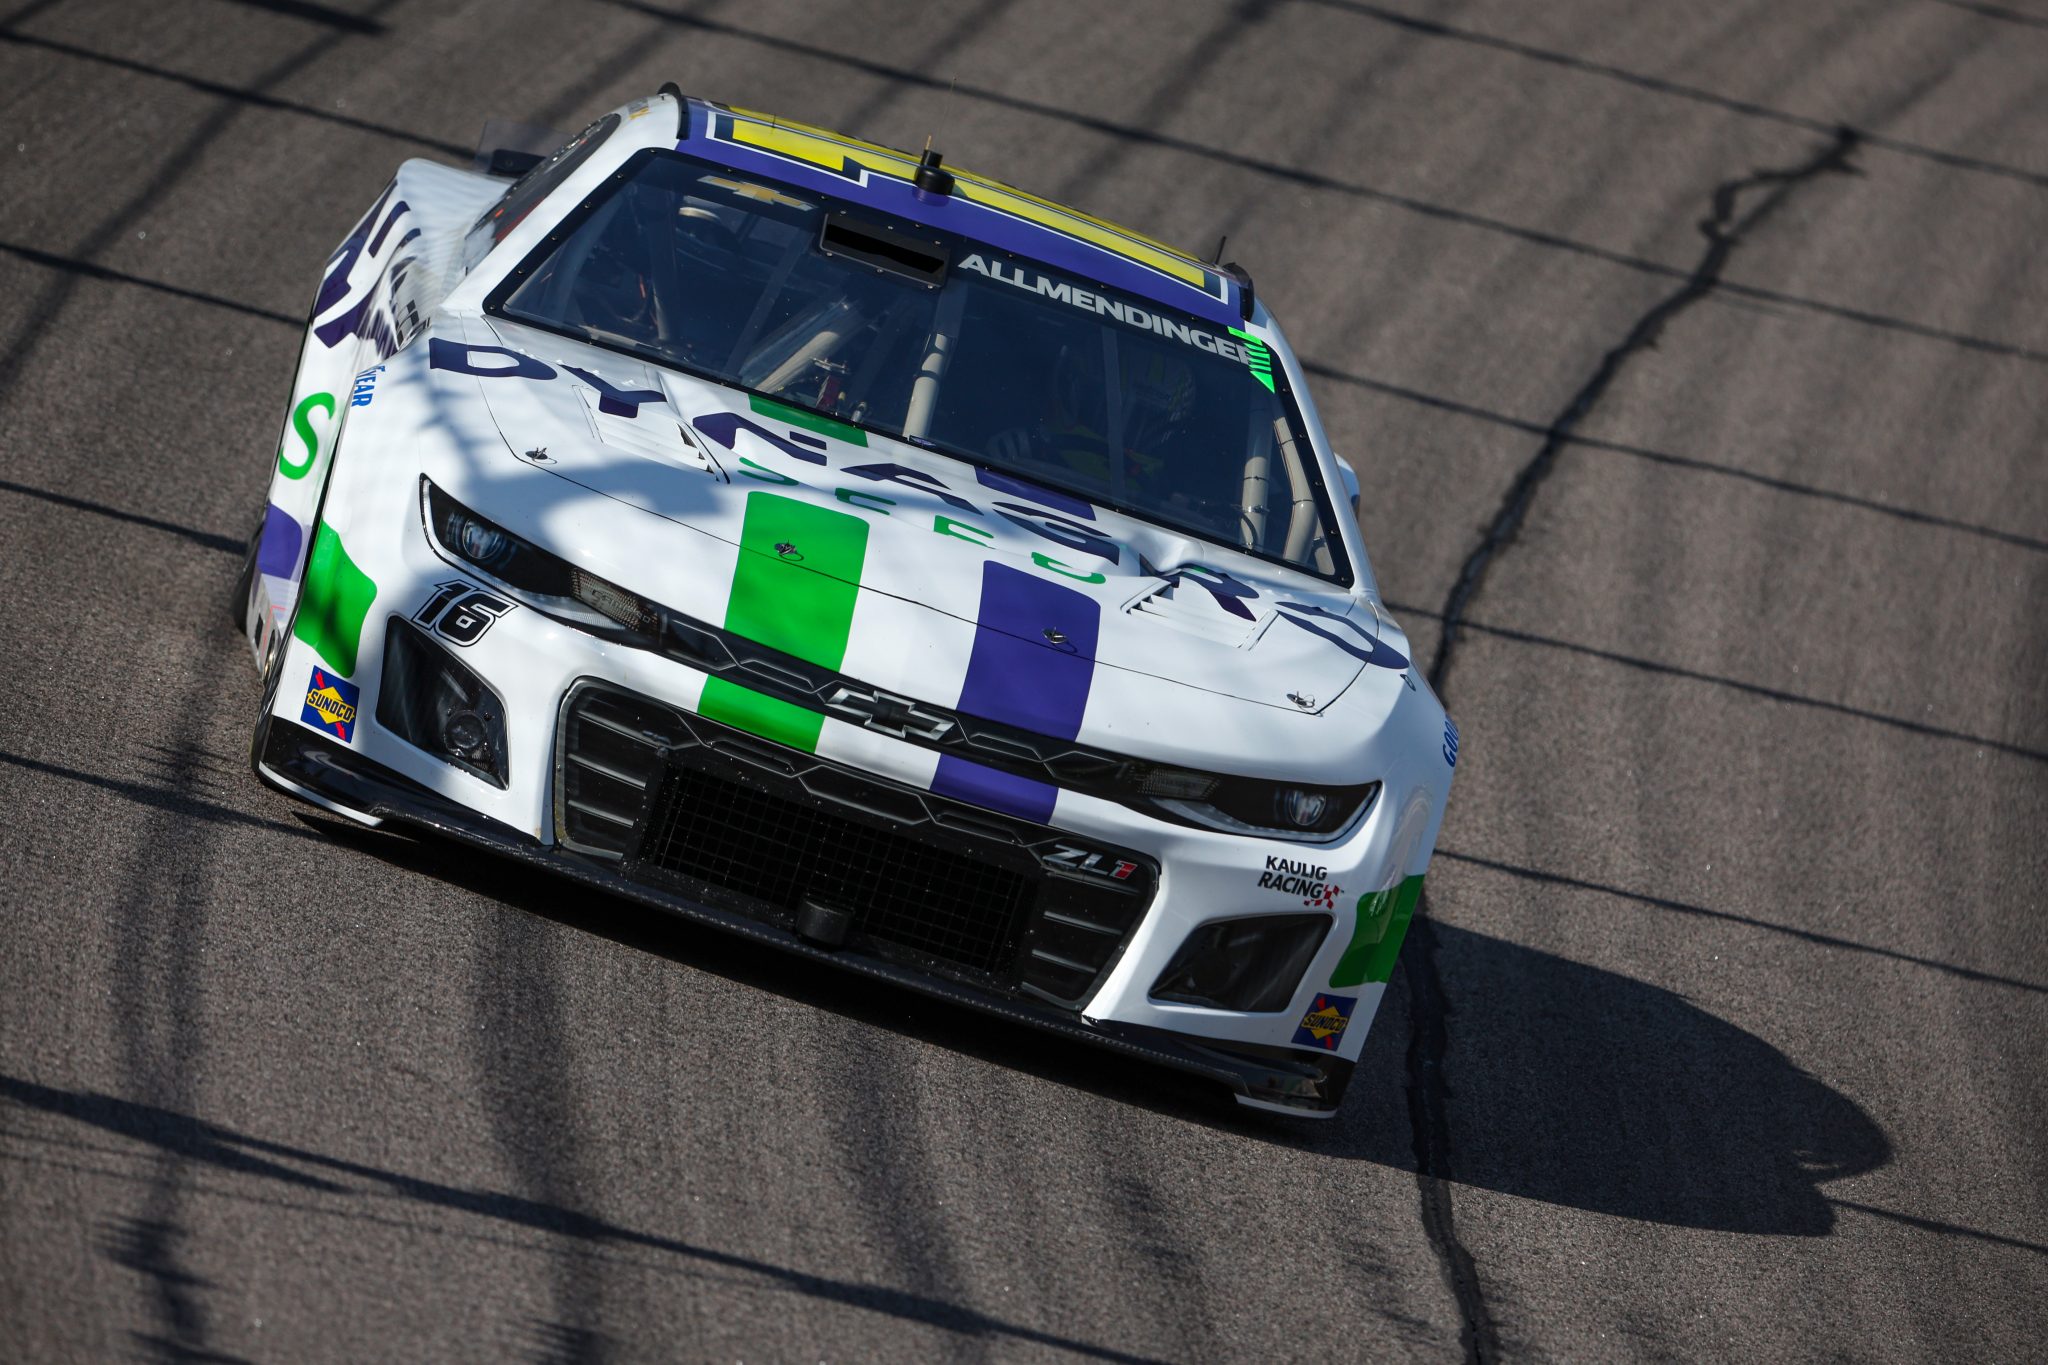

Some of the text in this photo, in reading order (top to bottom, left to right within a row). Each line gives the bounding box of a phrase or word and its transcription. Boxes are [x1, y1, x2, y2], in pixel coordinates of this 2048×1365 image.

[411, 579, 519, 647] 16
[308, 690, 353, 721] SUNOCO
[1042, 844, 1138, 880] ZL1
[1266, 855, 1328, 880] KAULIG
[1257, 871, 1324, 898] RACING
[1303, 1012, 1346, 1032] SUNOCO
